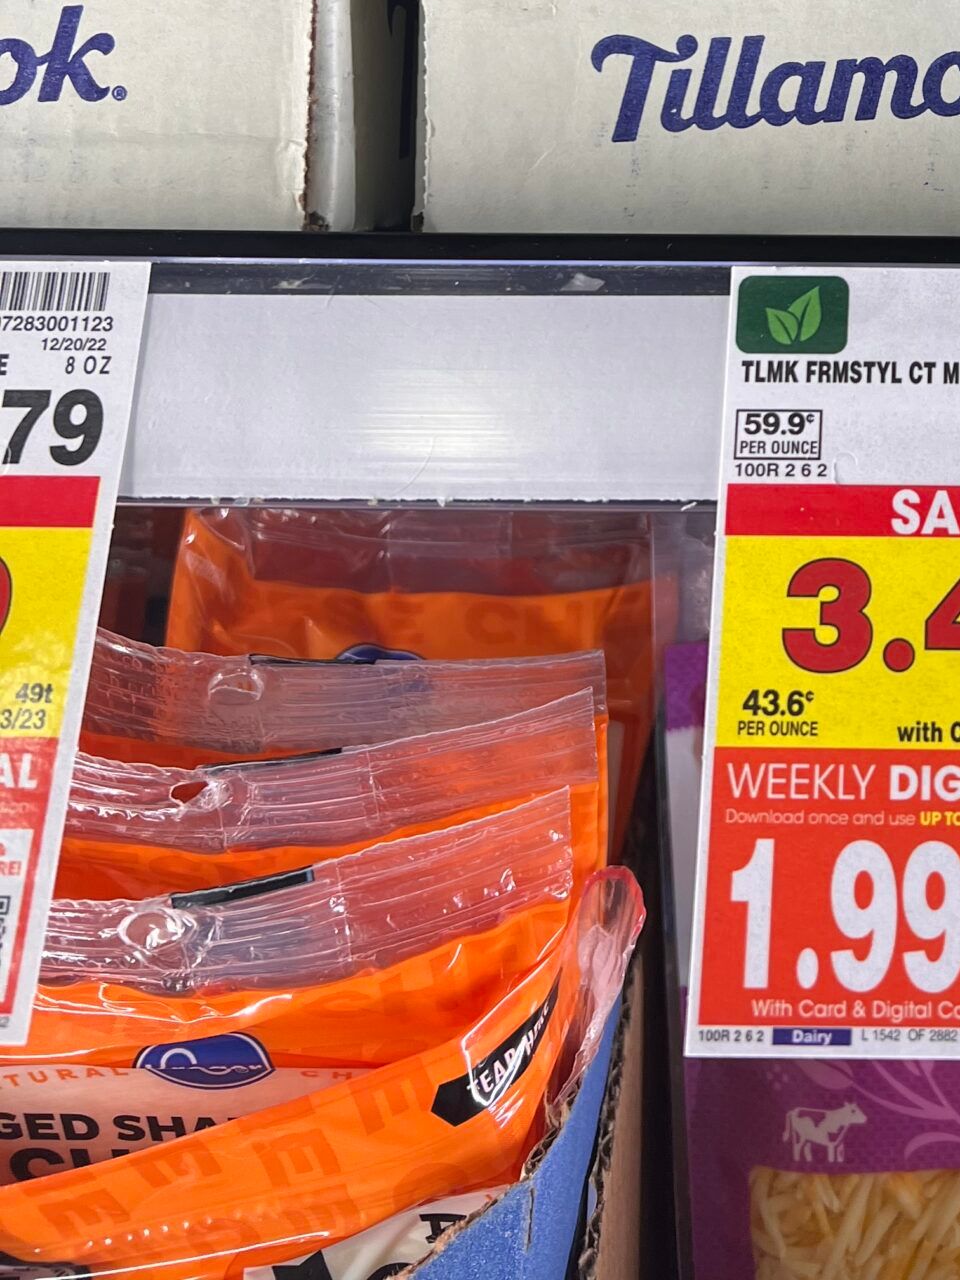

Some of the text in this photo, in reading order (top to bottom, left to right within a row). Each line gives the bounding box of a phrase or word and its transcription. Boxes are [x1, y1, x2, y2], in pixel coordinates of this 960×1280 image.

[42, 337, 107, 351] 12/20/22
[65, 356, 112, 375] 8 OZ
[742, 360, 799, 383] TLMK
[806, 361, 902, 384] FRMSTYL
[909, 361, 936, 384] CT
[740, 440, 818, 456] PER OUNCE
[735, 463, 828, 478] 100R 2 6 2
[16, 683, 53, 703] 49t
[737, 721, 818, 737] PER OUNCE
[897, 721, 946, 743] with
[727, 763, 876, 800] WEEKLY
[725, 808, 804, 824] Download
[808, 811, 849, 825] once
[853, 810, 885, 825] and
[889, 813, 915, 826] use
[919, 810, 941, 826] UP
[751, 1000, 793, 1017] With
[798, 1000, 850, 1018] Card
[852, 1001, 868, 1017] &
[871, 1000, 933, 1022] Digital
[698, 1030, 729, 1042] 100R
[791, 1029, 832, 1045] Dairy
[861, 1031, 868, 1042] L
[873, 1031, 901, 1042] 1542
[907, 1031, 924, 1042] OF
[930, 1031, 958, 1043] 2882
[0, 1067, 129, 1089] TURAL
